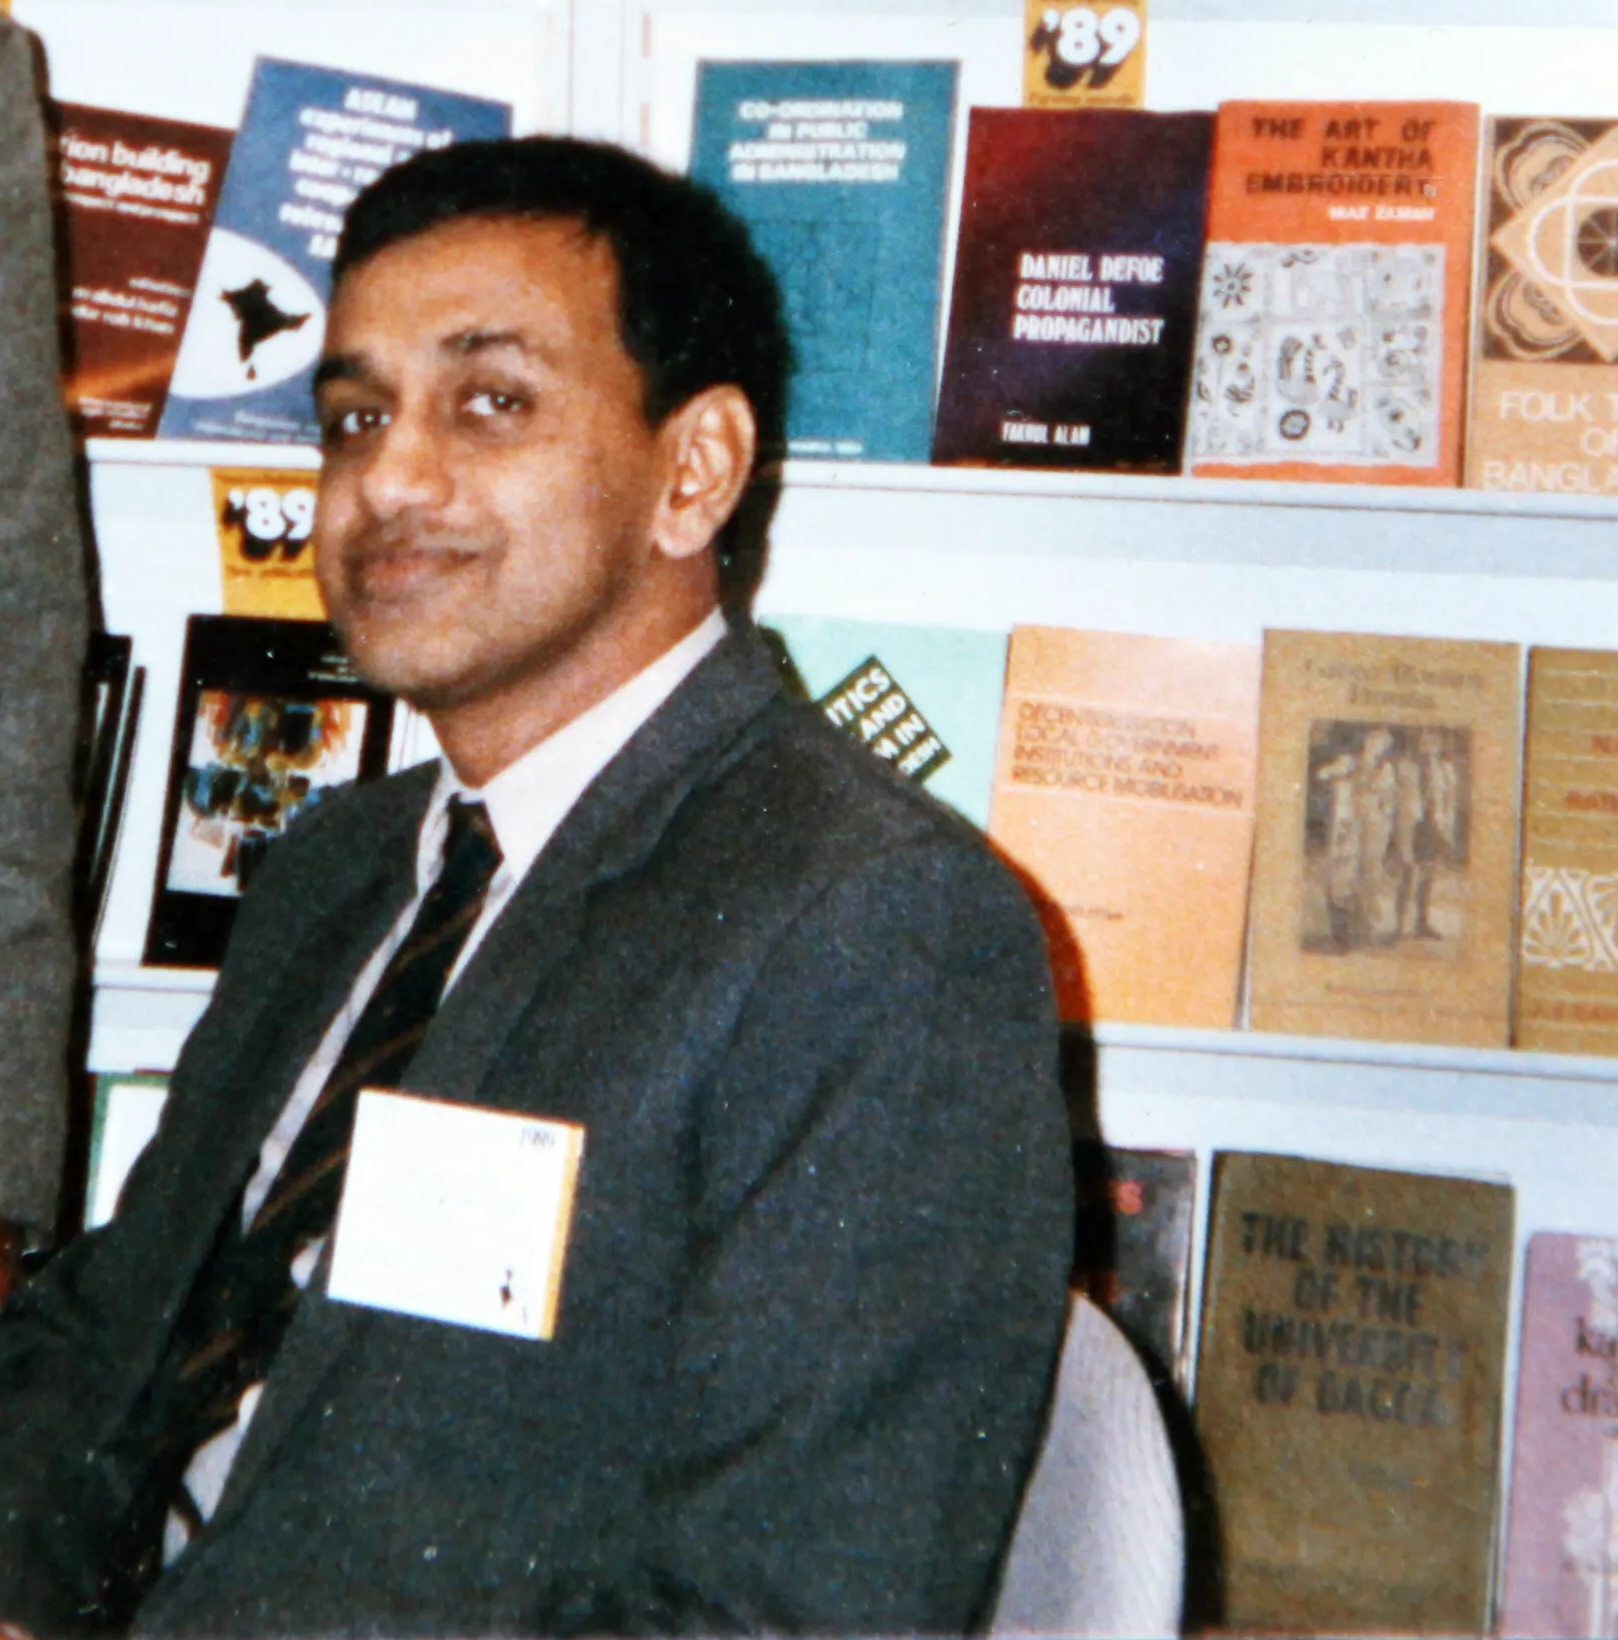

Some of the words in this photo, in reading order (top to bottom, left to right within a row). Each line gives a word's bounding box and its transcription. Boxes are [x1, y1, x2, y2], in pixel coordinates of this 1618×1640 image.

[1043, 7, 1142, 65] '89
[1251, 117, 1306, 142] THE
[1324, 117, 1377, 142] ART
[1401, 118, 1439, 142] OF
[110, 139, 212, 186] building
[1320, 146, 1433, 170] KANTHA
[1245, 172, 1438, 199] EMBROIDERY
[1019, 253, 1093, 283] DANIEL
[1099, 254, 1165, 284] DEFOE
[1016, 285, 1116, 315] COLONIAL
[1012, 313, 1166, 346] PROPAGANDIST
[1499, 391, 1588, 424] FOLK
[228, 487, 317, 541] '89
[823, 666, 892, 728] ITICS
[1240, 1210, 1305, 1259] THE
[1323, 1221, 1492, 1278] HISTORY
[1291, 1274, 1338, 1312] OF
[1356, 1275, 1425, 1324] THE
[1240, 1306, 1468, 1382] UNIVERSITY
[1254, 1360, 1298, 1405] OF
[1314, 1377, 1445, 1427] DACCA
